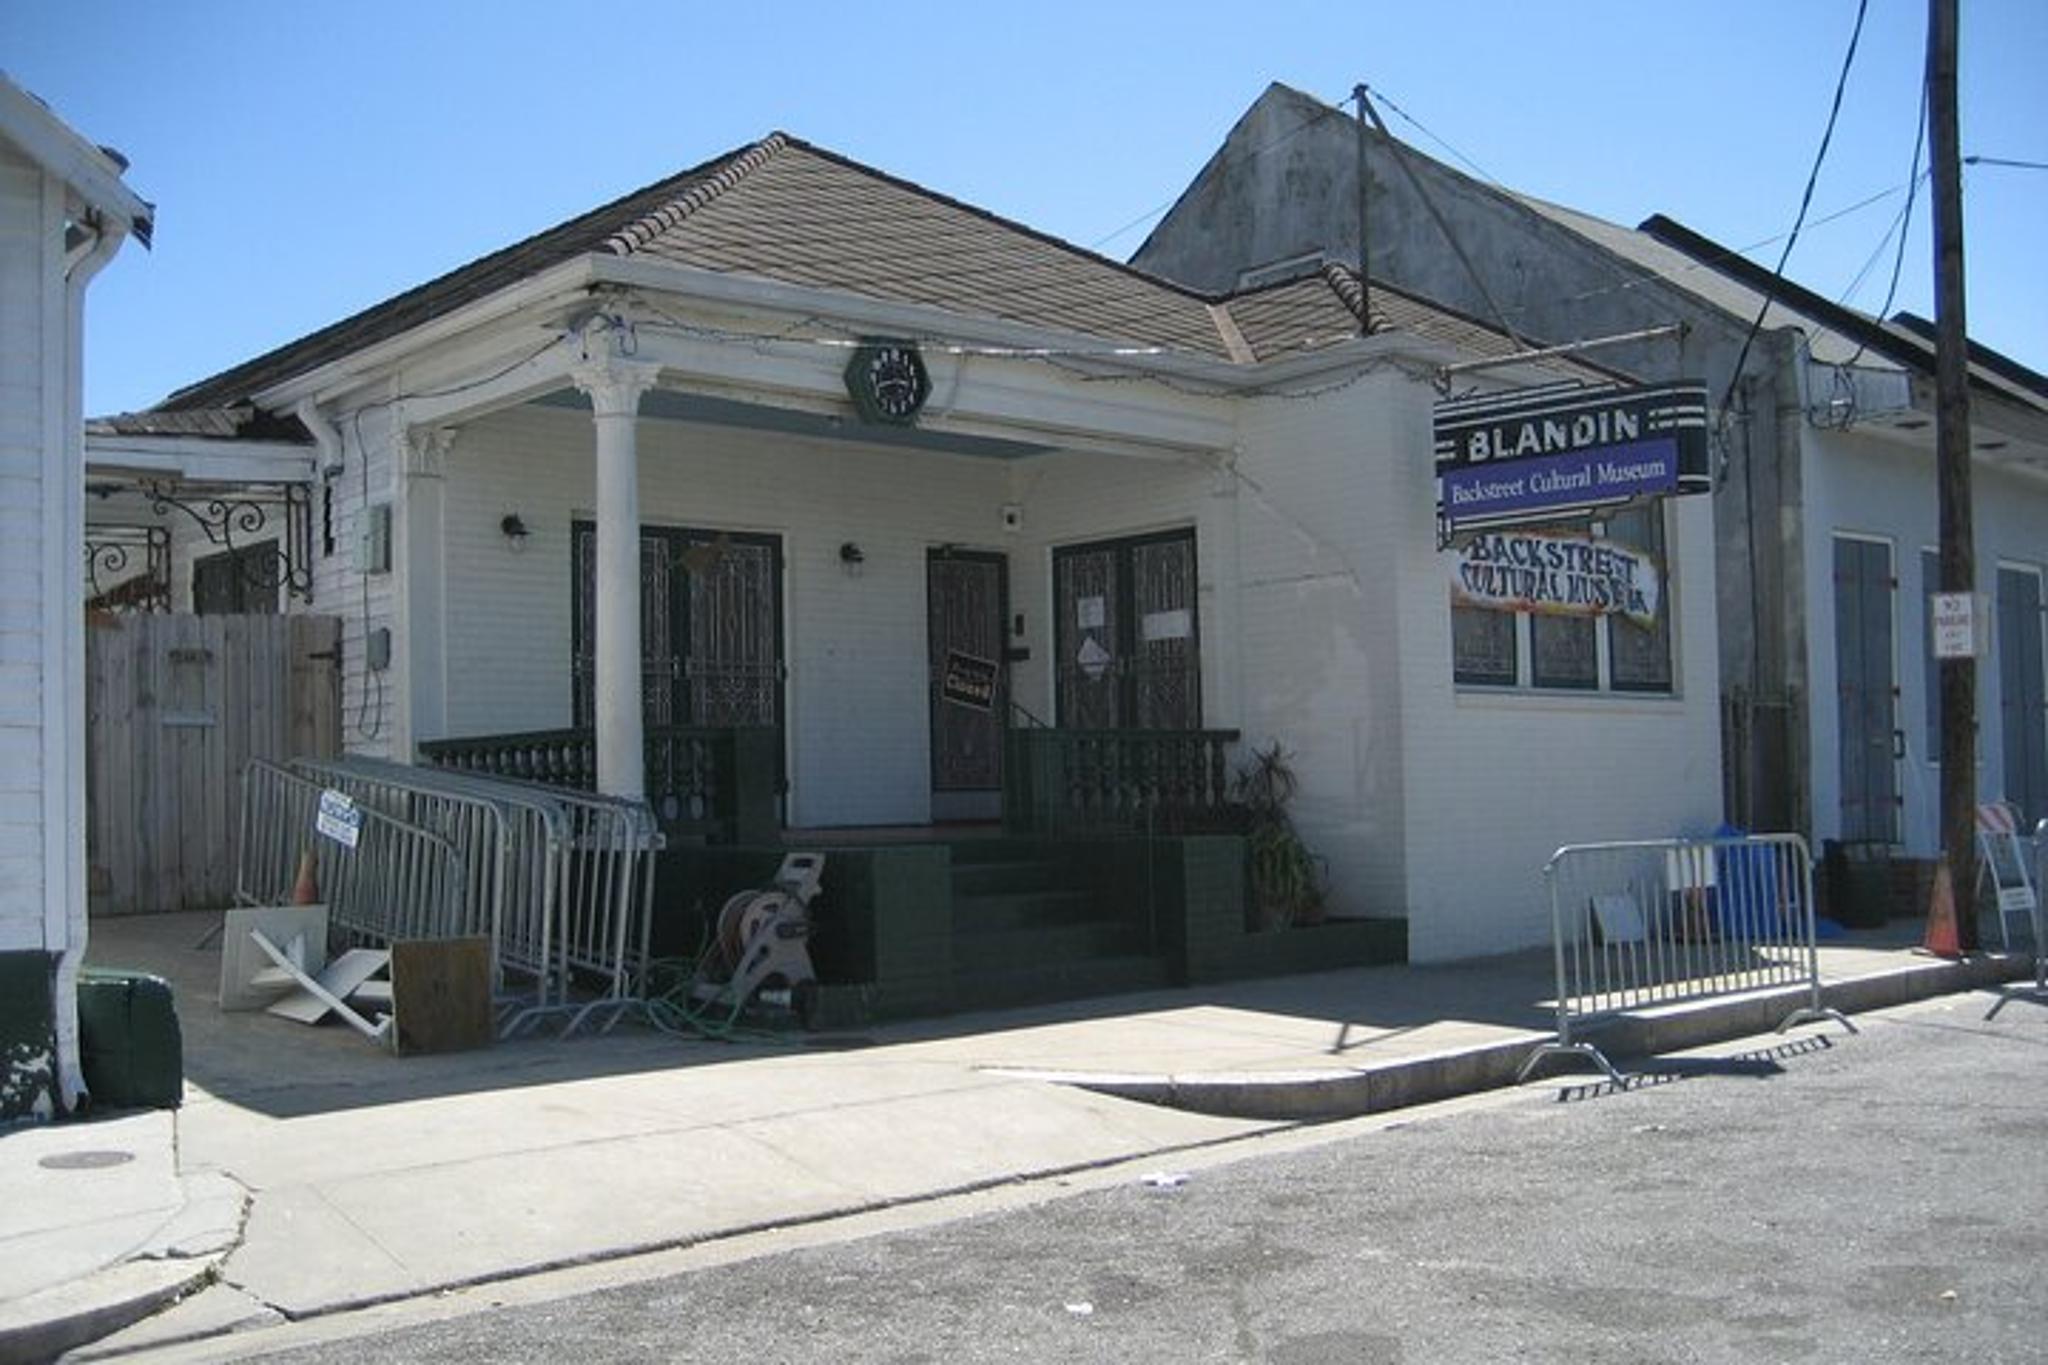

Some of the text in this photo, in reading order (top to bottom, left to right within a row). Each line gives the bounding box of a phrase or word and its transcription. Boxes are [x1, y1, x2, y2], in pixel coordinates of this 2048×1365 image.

[1469, 409, 1639, 461] BLANDIN
[1453, 459, 1666, 504] Backstreet Cultural Museum
[1468, 534, 1639, 580] BACKSTREET
[1460, 562, 1563, 603] CULTURAL
